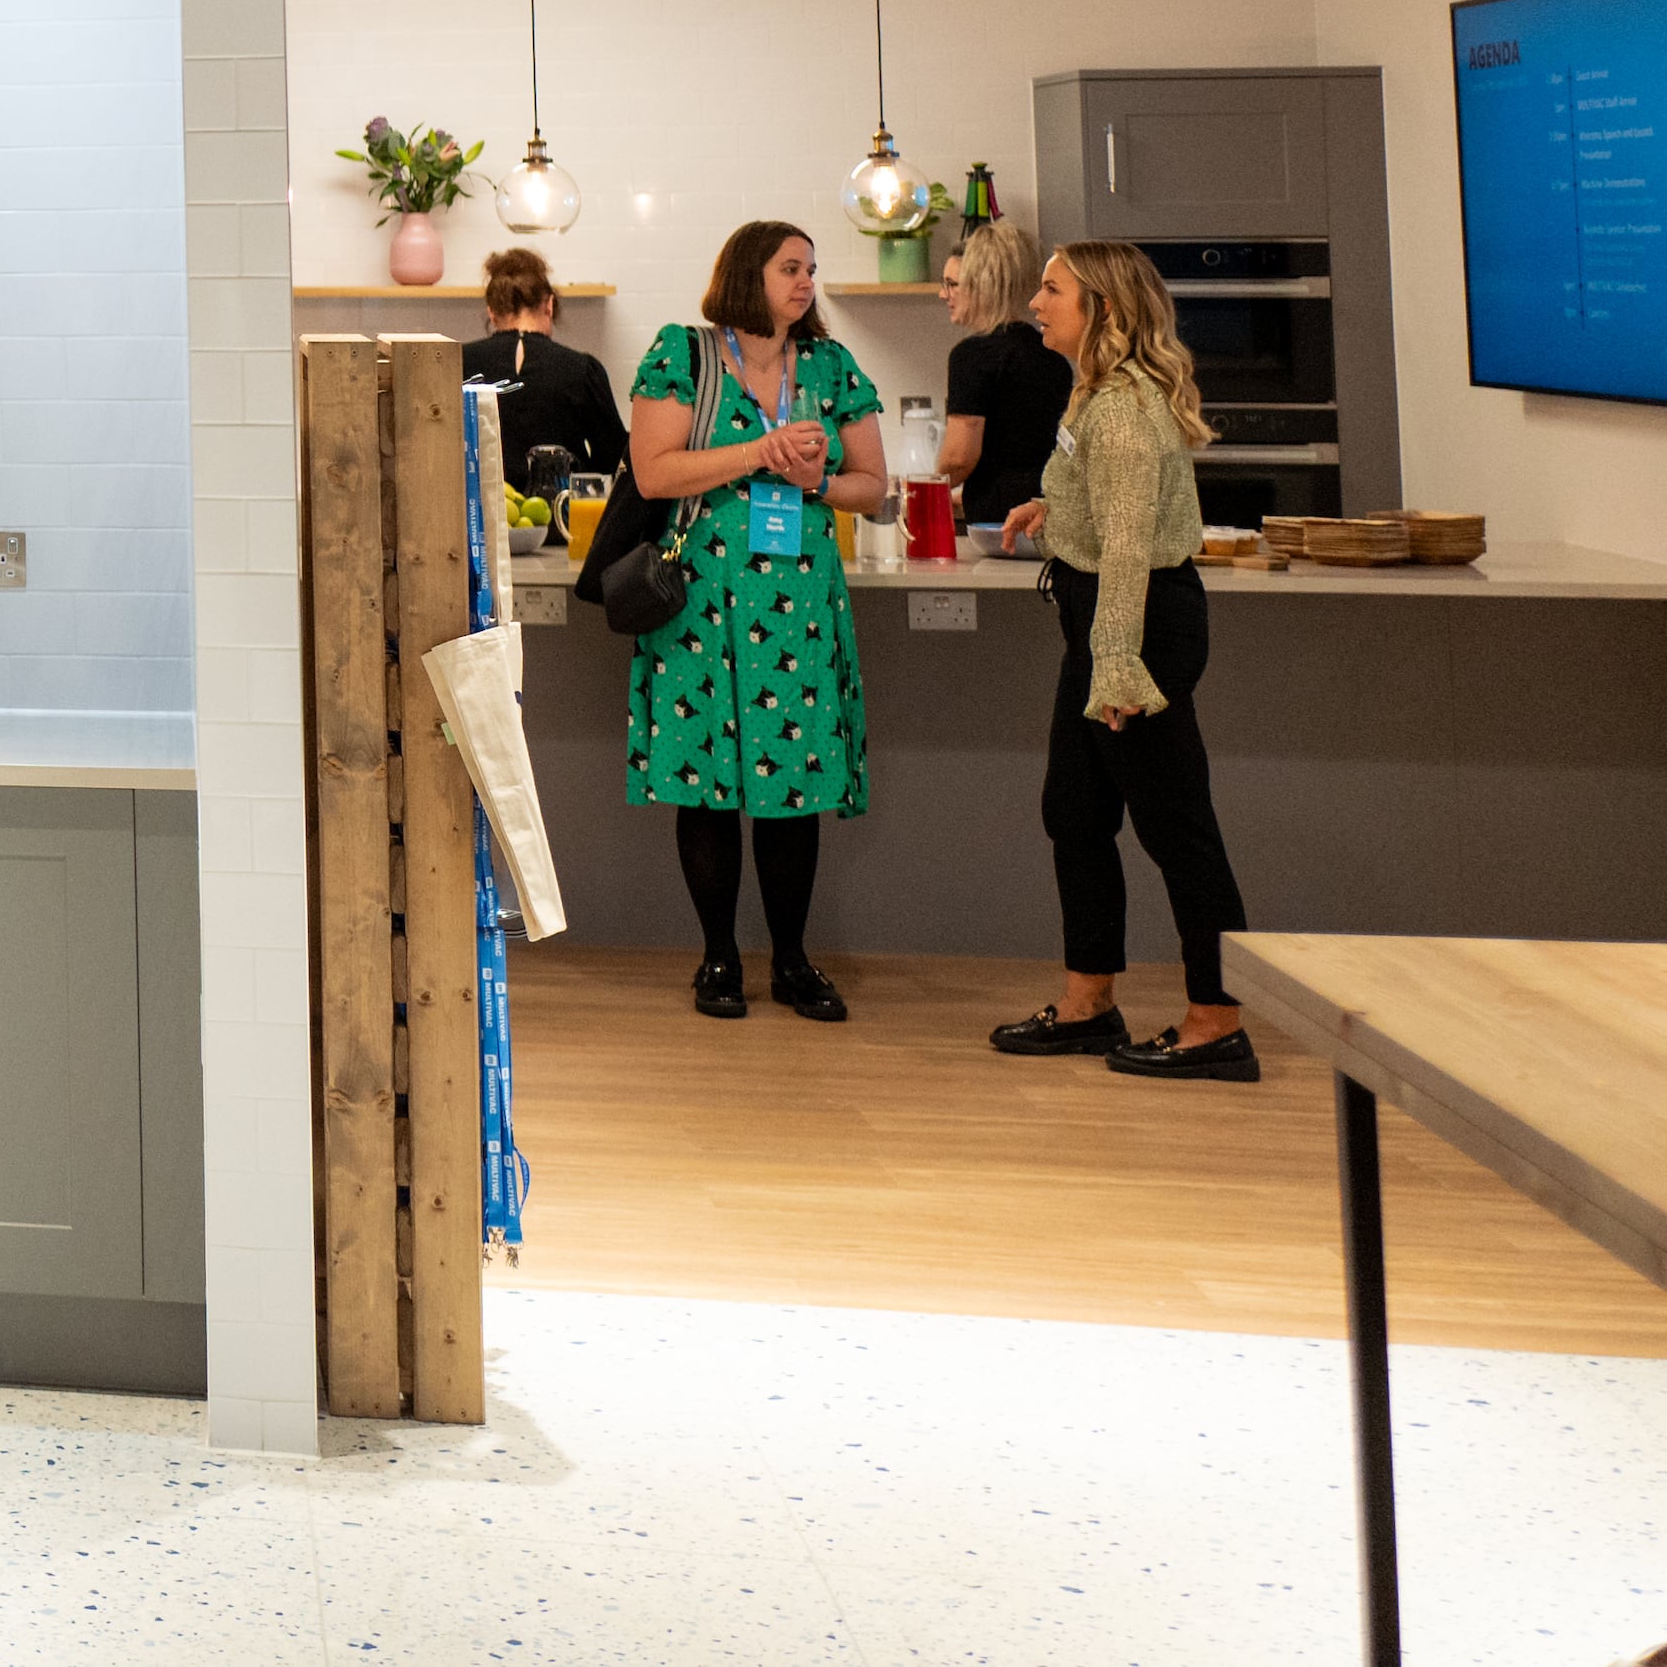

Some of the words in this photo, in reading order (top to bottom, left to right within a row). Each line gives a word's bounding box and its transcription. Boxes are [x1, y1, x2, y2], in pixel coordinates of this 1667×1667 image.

[1469, 40, 1521, 70] AGENDA
[480, 545, 488, 590] MULTIVAC
[484, 982, 493, 1028] MULTIVAC
[497, 996, 506, 1042] MULTIVAC
[489, 1068, 497, 1115] MULTIVAC
[489, 1155, 499, 1202] MULTIVAC
[506, 1170, 516, 1217] MULTIVAC
